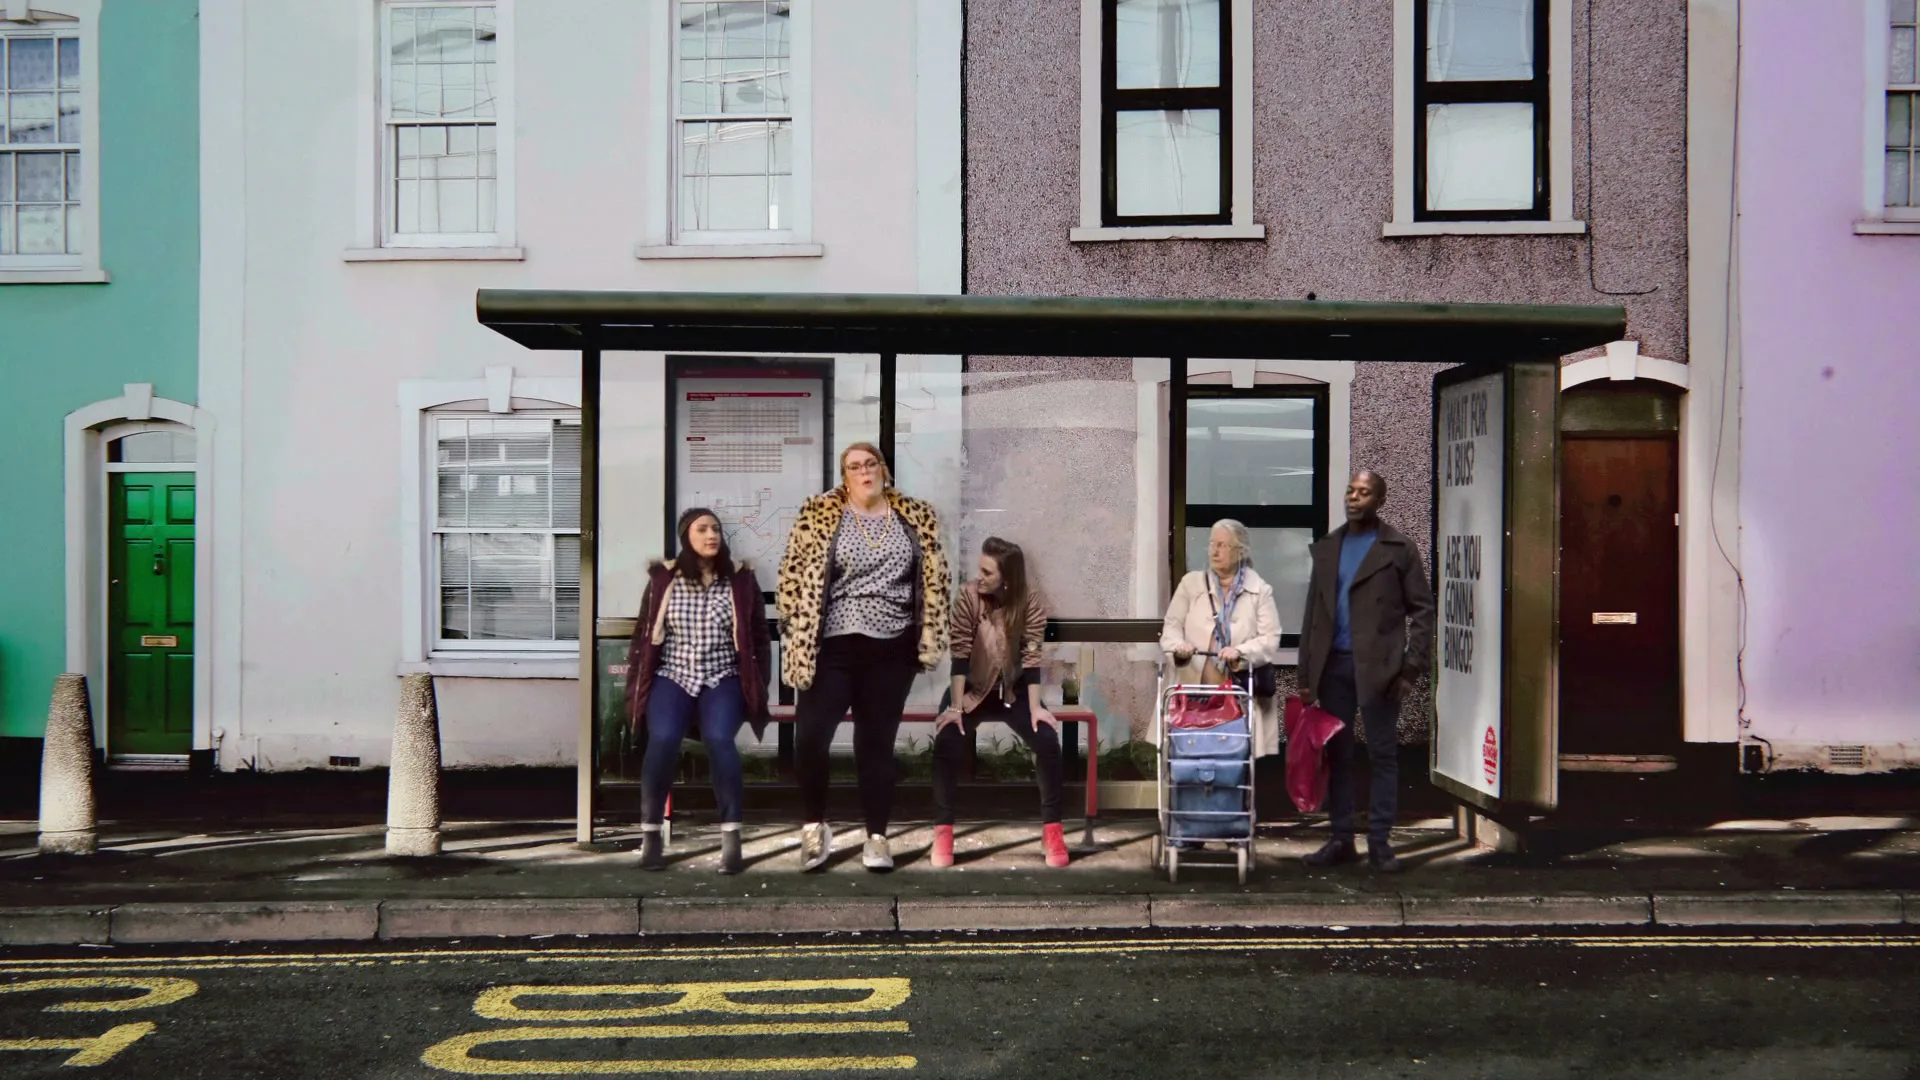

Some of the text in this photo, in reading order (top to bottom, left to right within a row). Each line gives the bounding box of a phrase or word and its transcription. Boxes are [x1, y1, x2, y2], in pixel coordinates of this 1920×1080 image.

[1446, 389, 1488, 442] WAIT FOR
[1446, 440, 1475, 487] A BUS?
[1445, 535, 1482, 581] ARE YOU
[1444, 580, 1475, 628] GONNA
[1444, 625, 1473, 675] BINGO?
